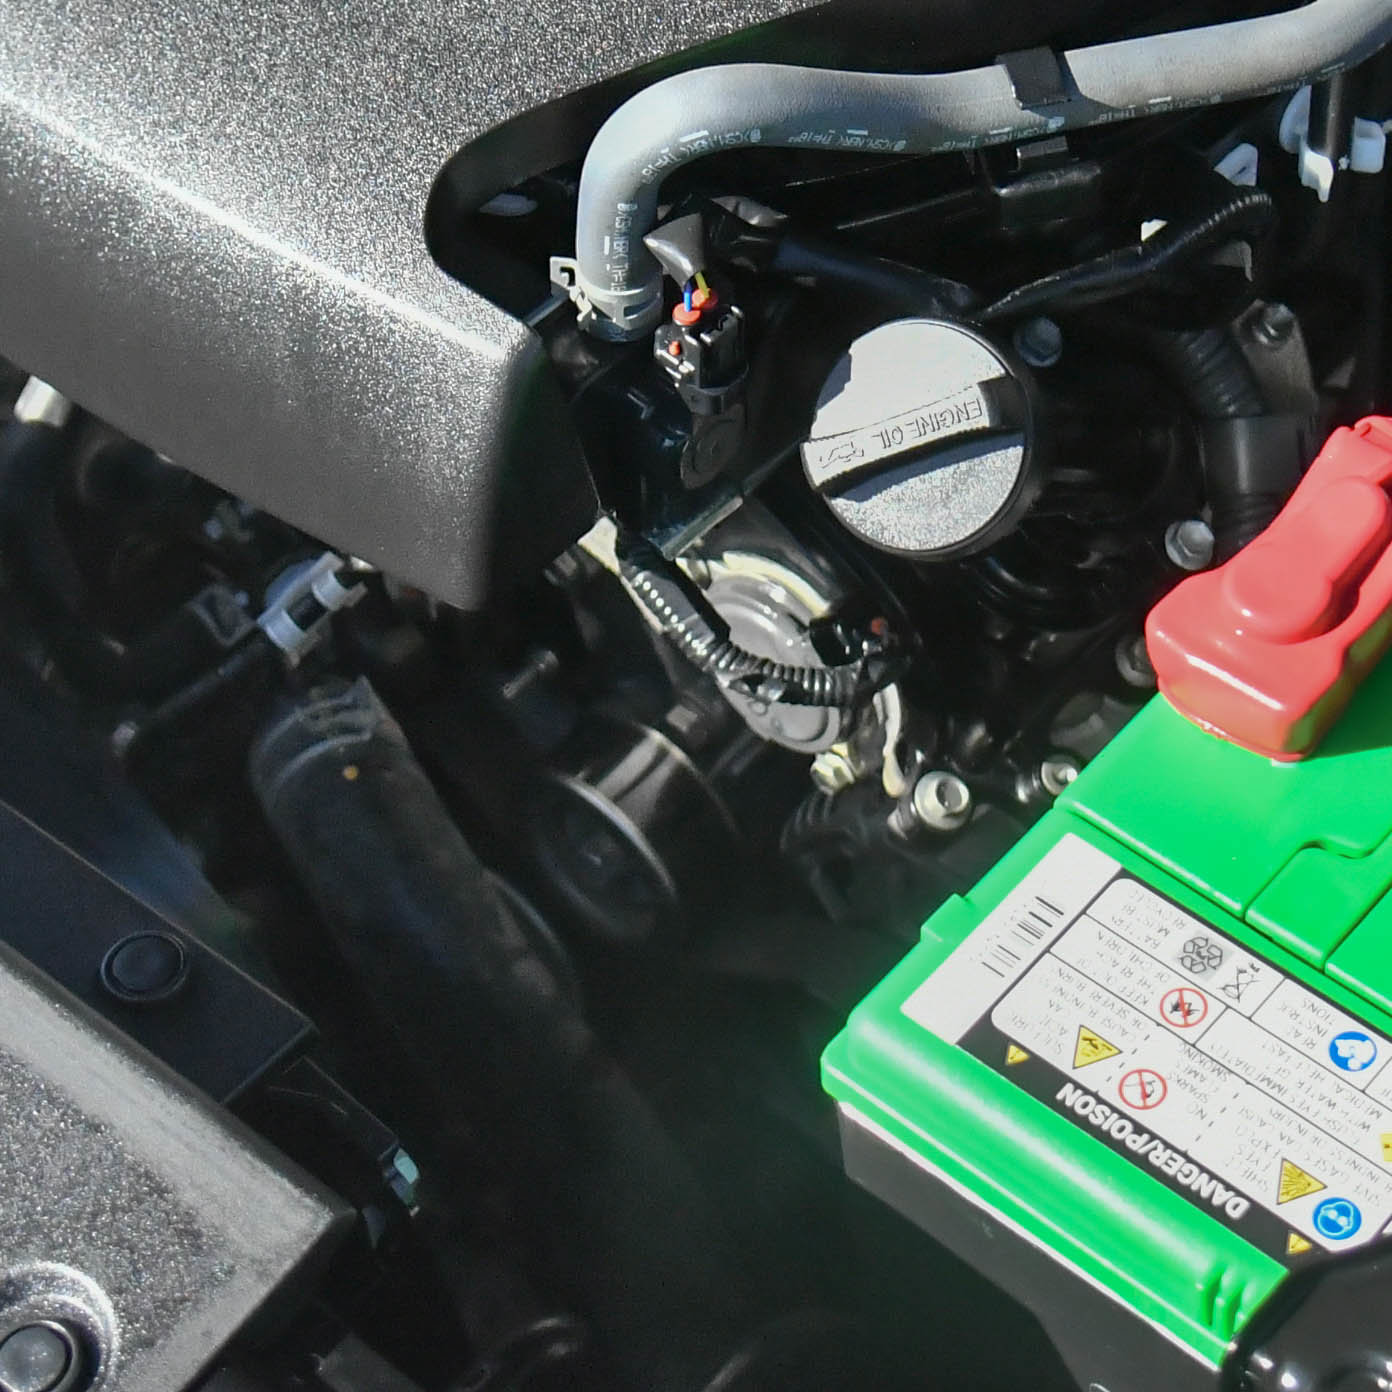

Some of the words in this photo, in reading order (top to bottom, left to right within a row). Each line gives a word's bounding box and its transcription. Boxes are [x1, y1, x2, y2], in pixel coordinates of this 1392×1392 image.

[872, 425, 905, 450] OIL
[907, 397, 983, 441] ENGINE
[1054, 1080, 1252, 1220] DANGER/POISON
